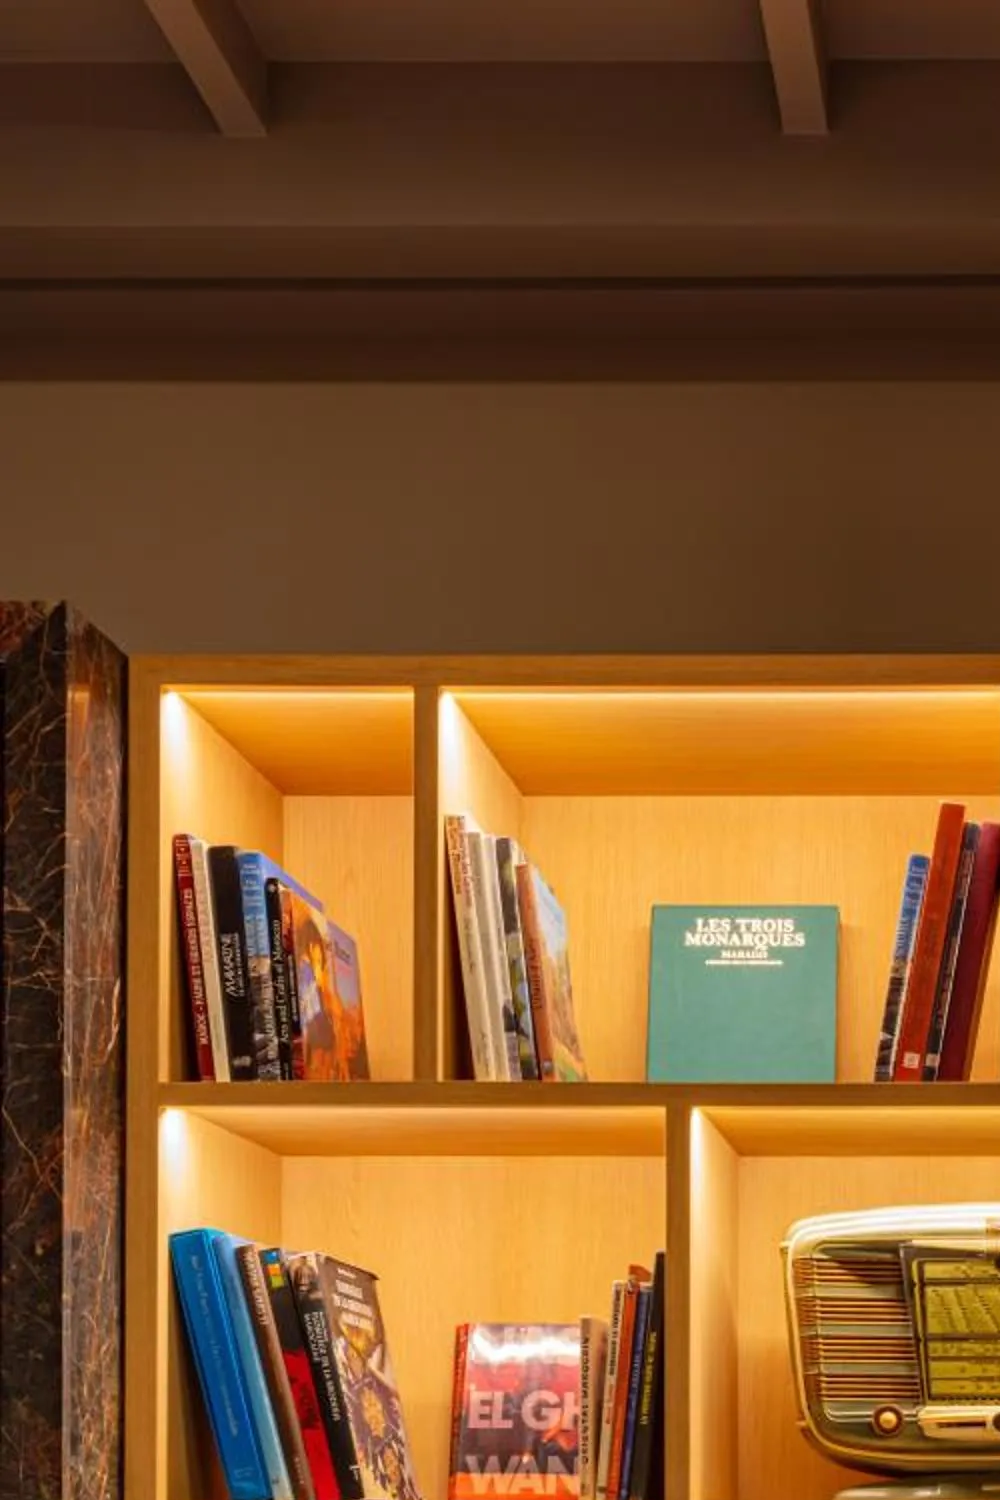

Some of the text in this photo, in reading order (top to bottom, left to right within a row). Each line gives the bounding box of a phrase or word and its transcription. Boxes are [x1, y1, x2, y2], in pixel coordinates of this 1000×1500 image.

[696, 918, 794, 932] LES TROIS
[684, 932, 805, 950] MONARQUES
[468, 1391, 513, 1429] EL
[580, 1337, 590, 1464] ORIENTAL MAROCAIN
